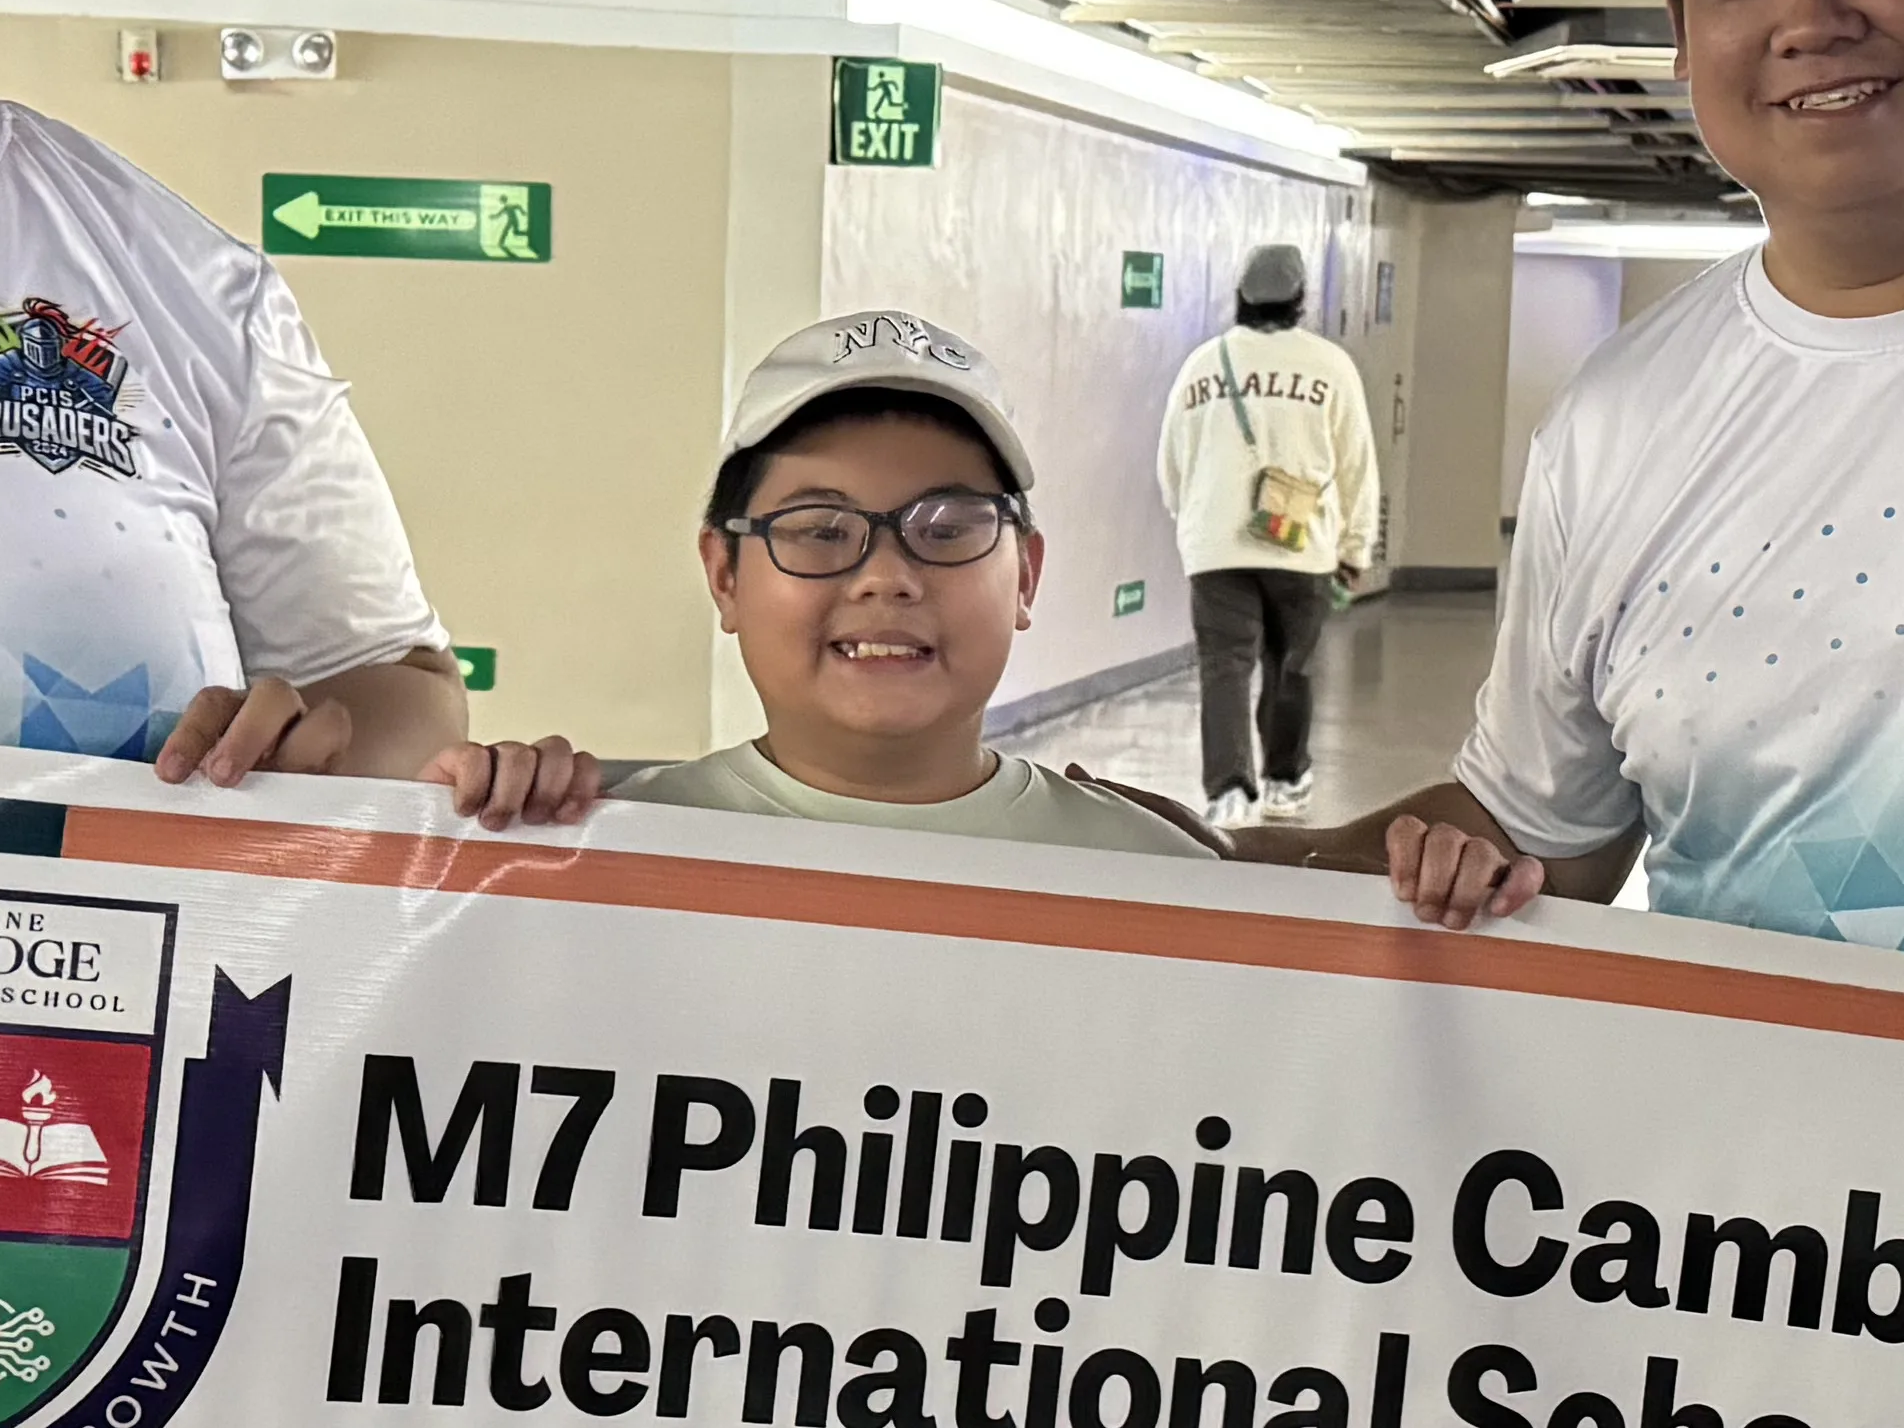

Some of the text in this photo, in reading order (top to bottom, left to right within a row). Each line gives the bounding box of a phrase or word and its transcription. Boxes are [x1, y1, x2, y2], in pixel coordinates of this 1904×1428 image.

[849, 120, 920, 162] EXIT
[324, 208, 462, 228] EXIT THIS WAY
[21, 385, 73, 408] PCIS
[2, 988, 124, 1012] SCHOOL
[350, 1054, 615, 1211] M7
[642, 1075, 1414, 1296] Philippine
